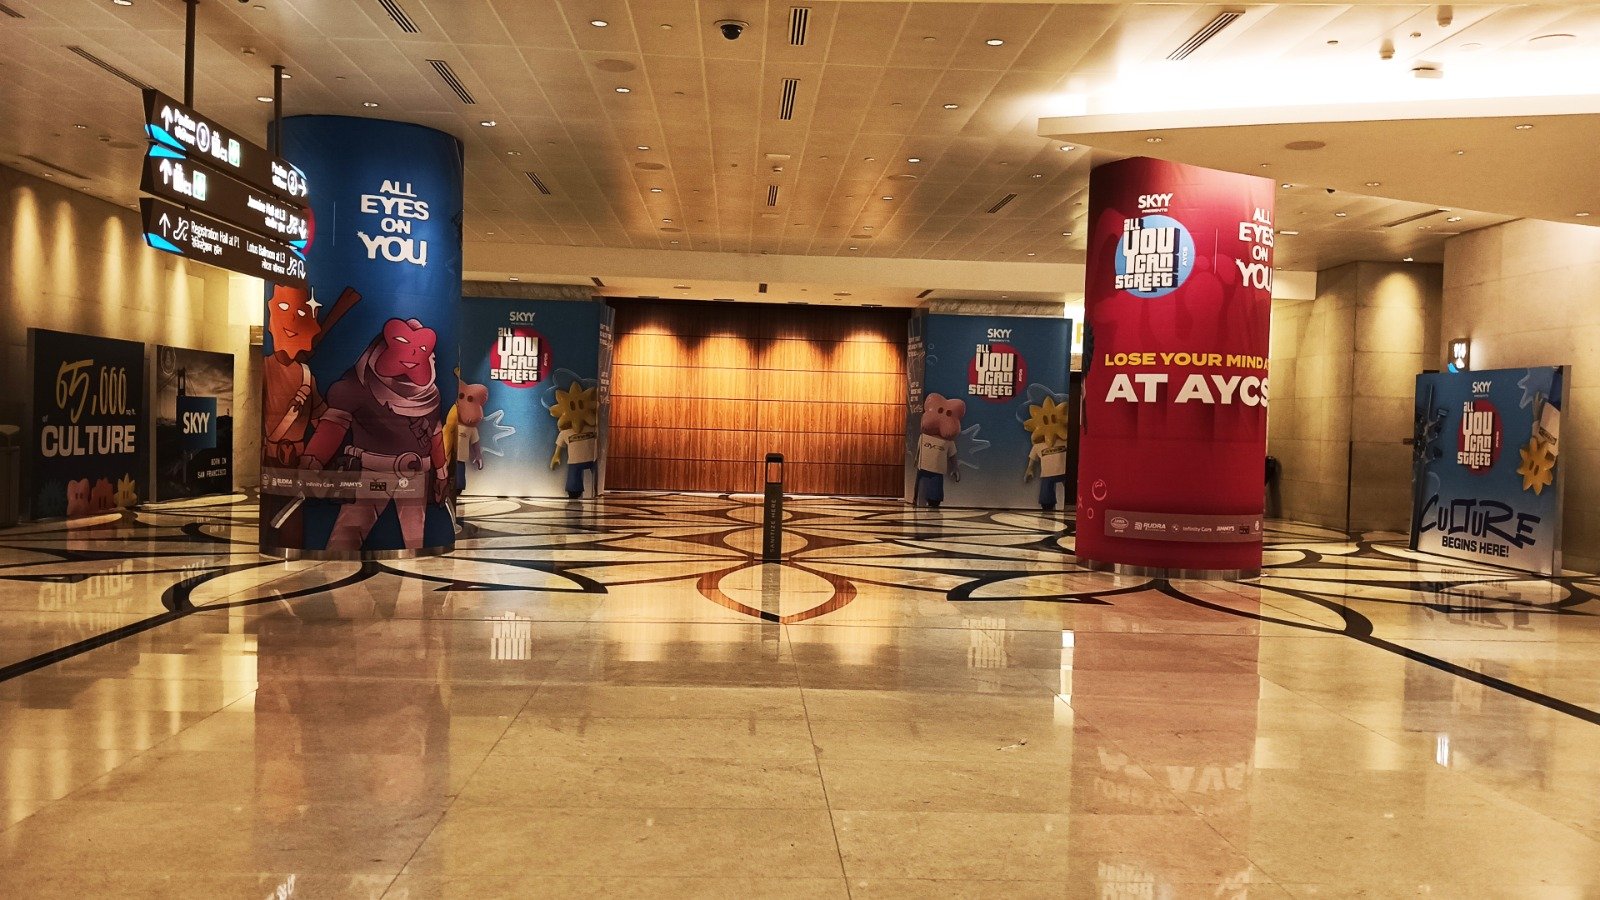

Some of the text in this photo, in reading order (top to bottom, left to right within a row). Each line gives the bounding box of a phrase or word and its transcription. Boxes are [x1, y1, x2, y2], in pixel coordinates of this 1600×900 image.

[380, 179, 417, 197] ALL
[361, 194, 429, 220] EYES
[1138, 193, 1173, 209] SKYY
[381, 217, 411, 234] ON
[1252, 207, 1271, 225] ALL
[191, 220, 219, 242] Registration
[219, 230, 229, 244] Hall
[357, 231, 427, 267] YOU
[1122, 227, 1175, 273] YOU
[1252, 245, 1268, 262] ON
[1235, 258, 1273, 292] YOU
[509, 311, 535, 322] SKYY
[987, 328, 1012, 339] SKYY
[497, 336, 539, 369] YOU
[1105, 353, 1156, 367] LOSE
[1160, 352, 1222, 367] YOUR
[1226, 354, 1263, 369] MIND
[975, 353, 1014, 385] YOU
[56, 359, 127, 424] 65,000
[1105, 373, 1168, 403] AT
[1472, 381, 1492, 393] SKYY
[183, 411, 210, 434] SKYY
[1462, 411, 1493, 452] YOU
[41, 425, 136, 458] CULTURE
[1143, 522, 1166, 531] RUDRA
[1419, 493, 1541, 549] CULTURE
[1442, 535, 1510, 558] BEGINS HERE!
